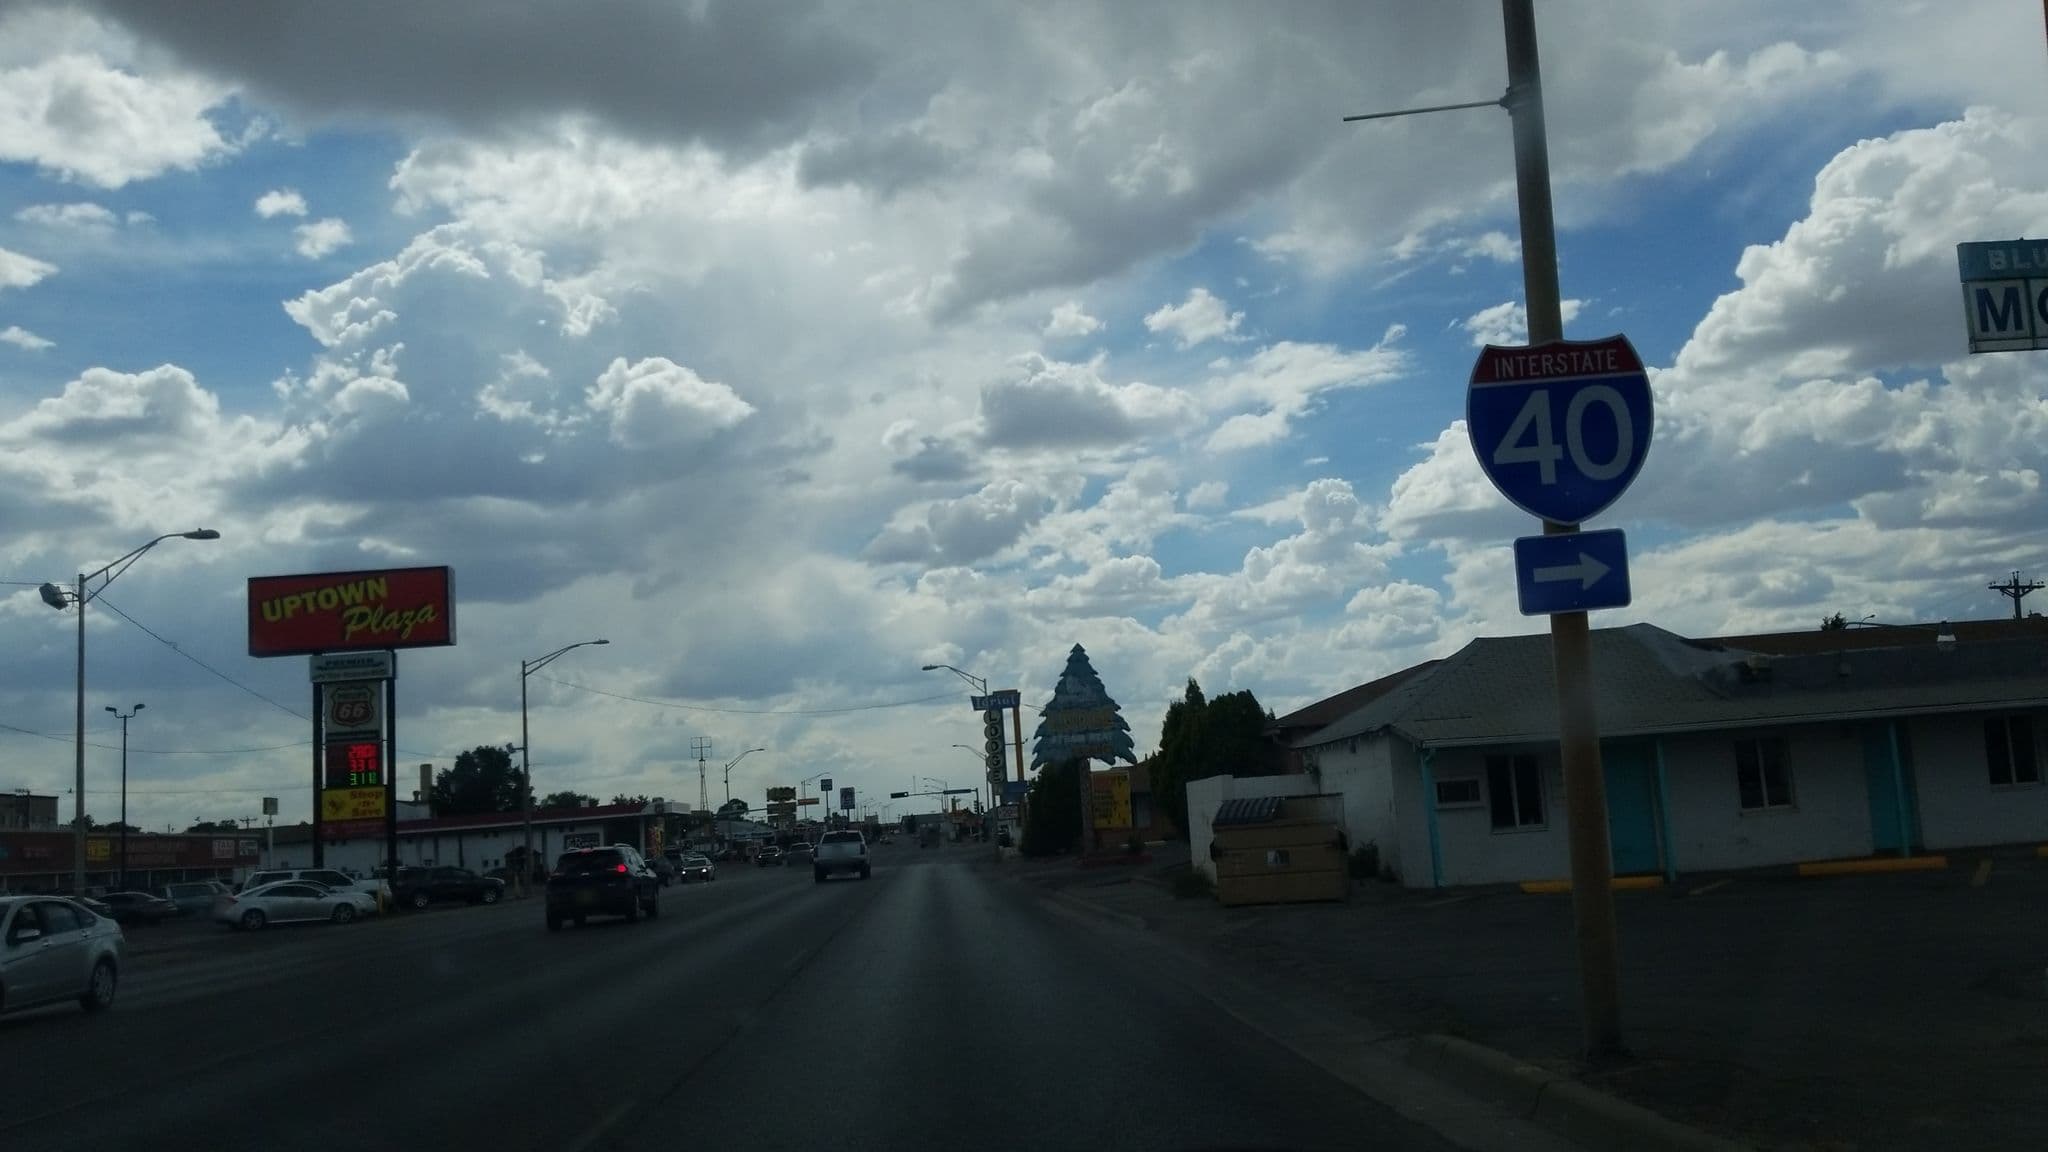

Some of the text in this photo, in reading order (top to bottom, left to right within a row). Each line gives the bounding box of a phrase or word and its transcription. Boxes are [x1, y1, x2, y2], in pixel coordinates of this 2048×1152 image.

[1976, 286, 2048, 333] M
[1494, 348, 1619, 379] INTERSTATE
[1493, 384, 1634, 486] 40
[262, 577, 389, 622] UPTOWN
[343, 603, 438, 641] Plaza
[339, 702, 370, 720] 66
[988, 709, 1002, 783] LODGE
